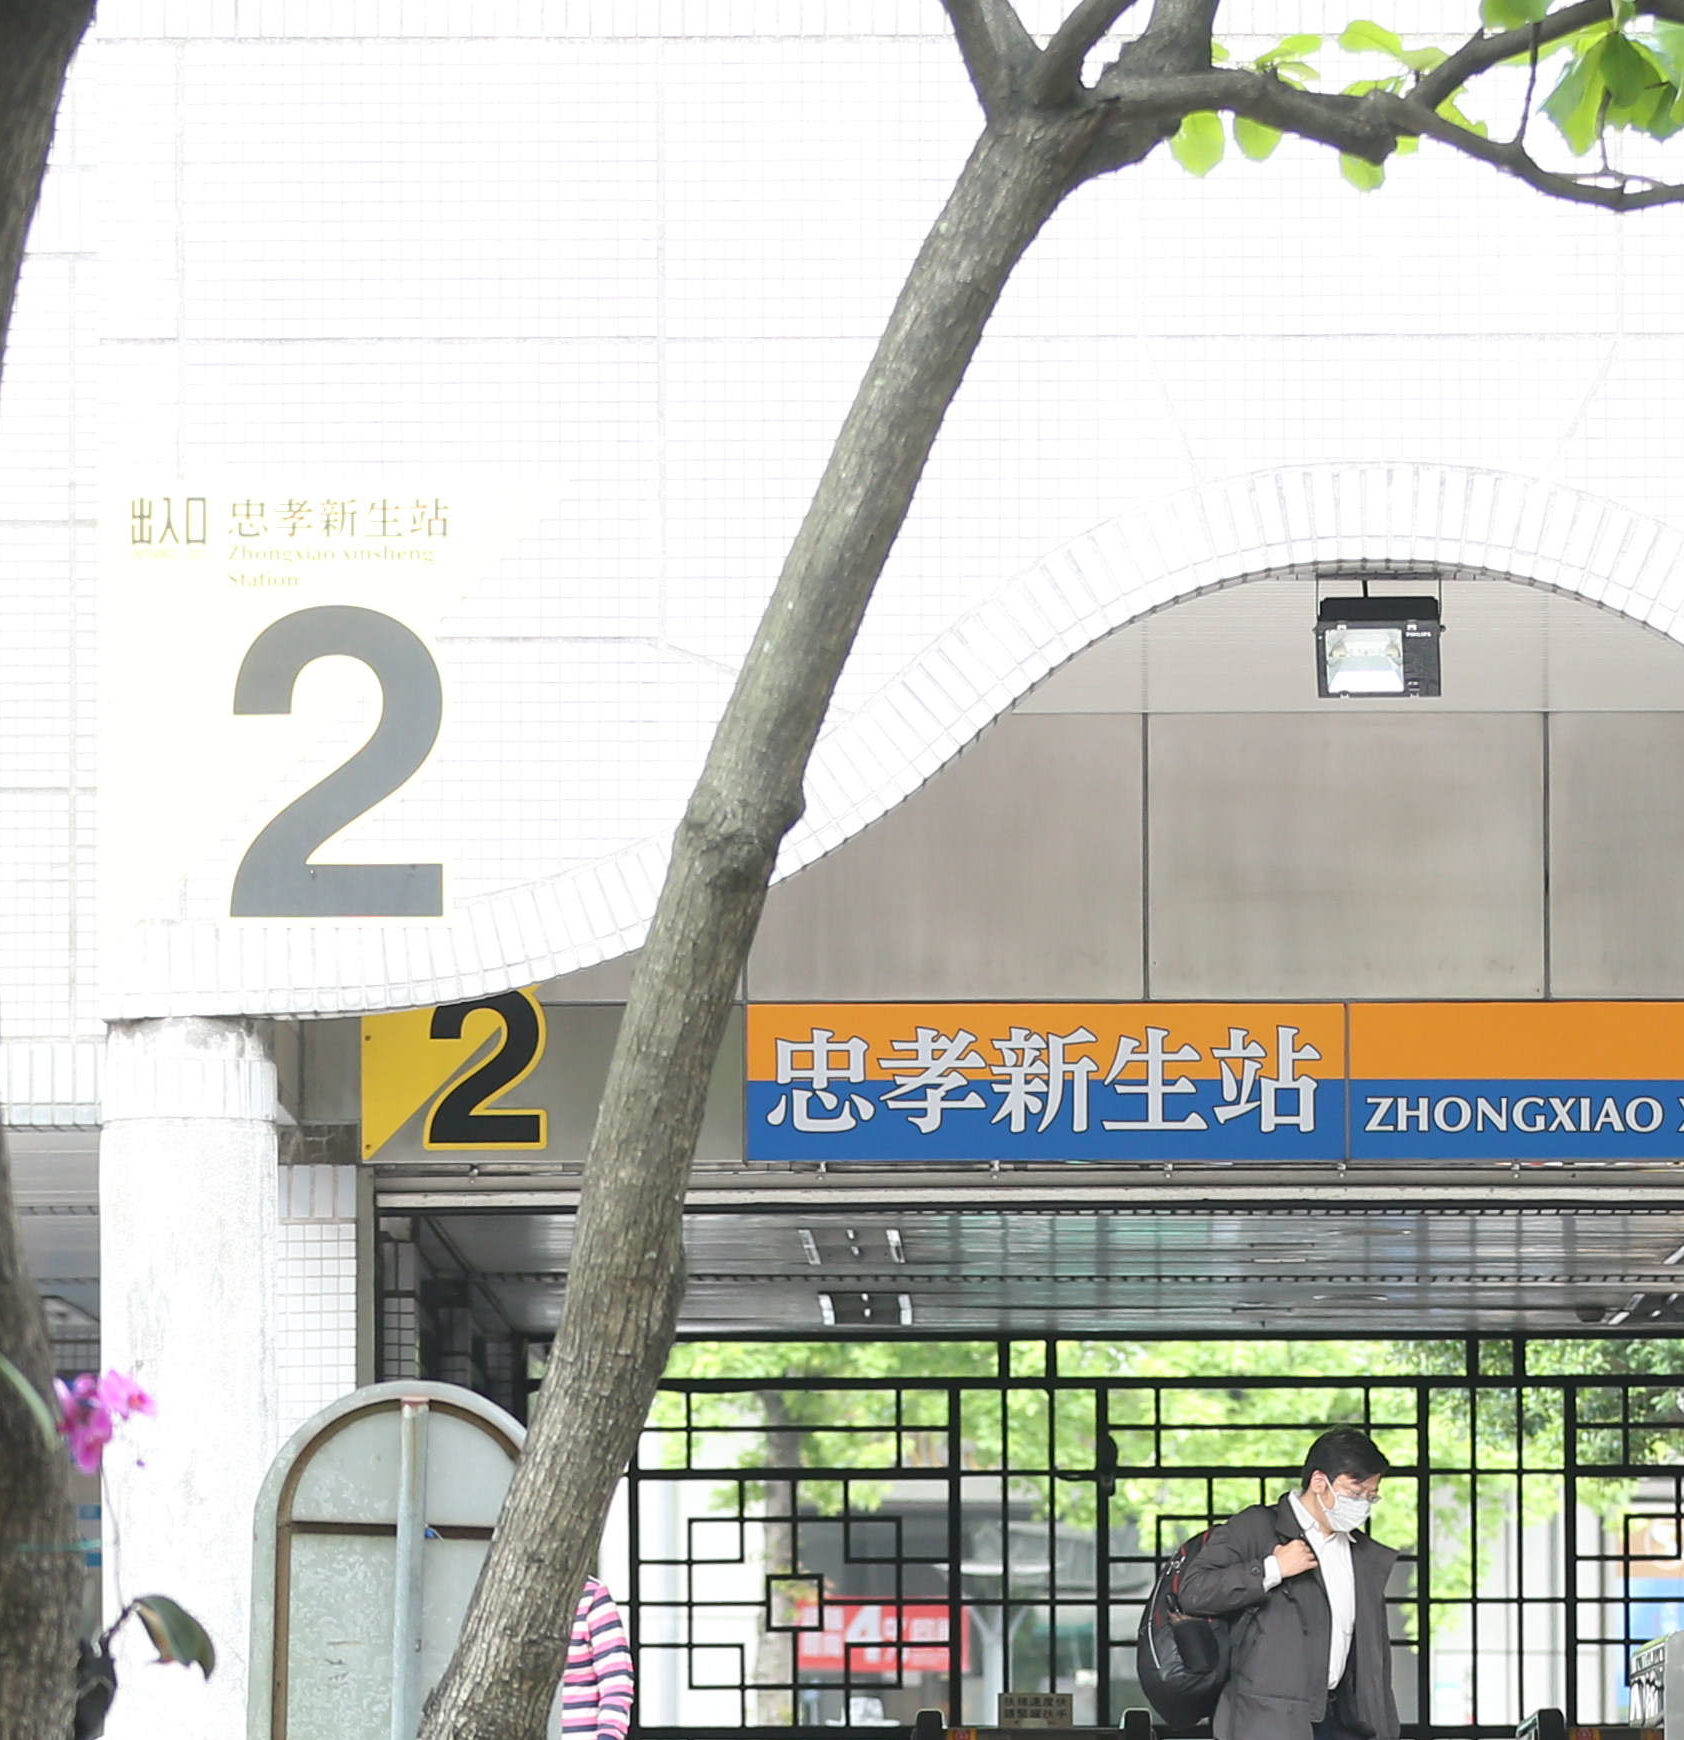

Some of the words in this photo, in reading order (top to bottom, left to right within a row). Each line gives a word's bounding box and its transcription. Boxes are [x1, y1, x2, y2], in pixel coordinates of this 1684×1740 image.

[131, 497, 206, 545] 出入口
[228, 498, 450, 538] 忠孝新生站
[228, 545, 335, 563] Zhongxiao
[343, 545, 434, 563] xinsheng
[228, 571, 299, 588] Station
[230, 604, 443, 917] 2
[429, 990, 540, 1144] 2
[765, 1025, 1322, 1134] 忠孝新生站
[1363, 1096, 1664, 1133] ZHONGXIAO
